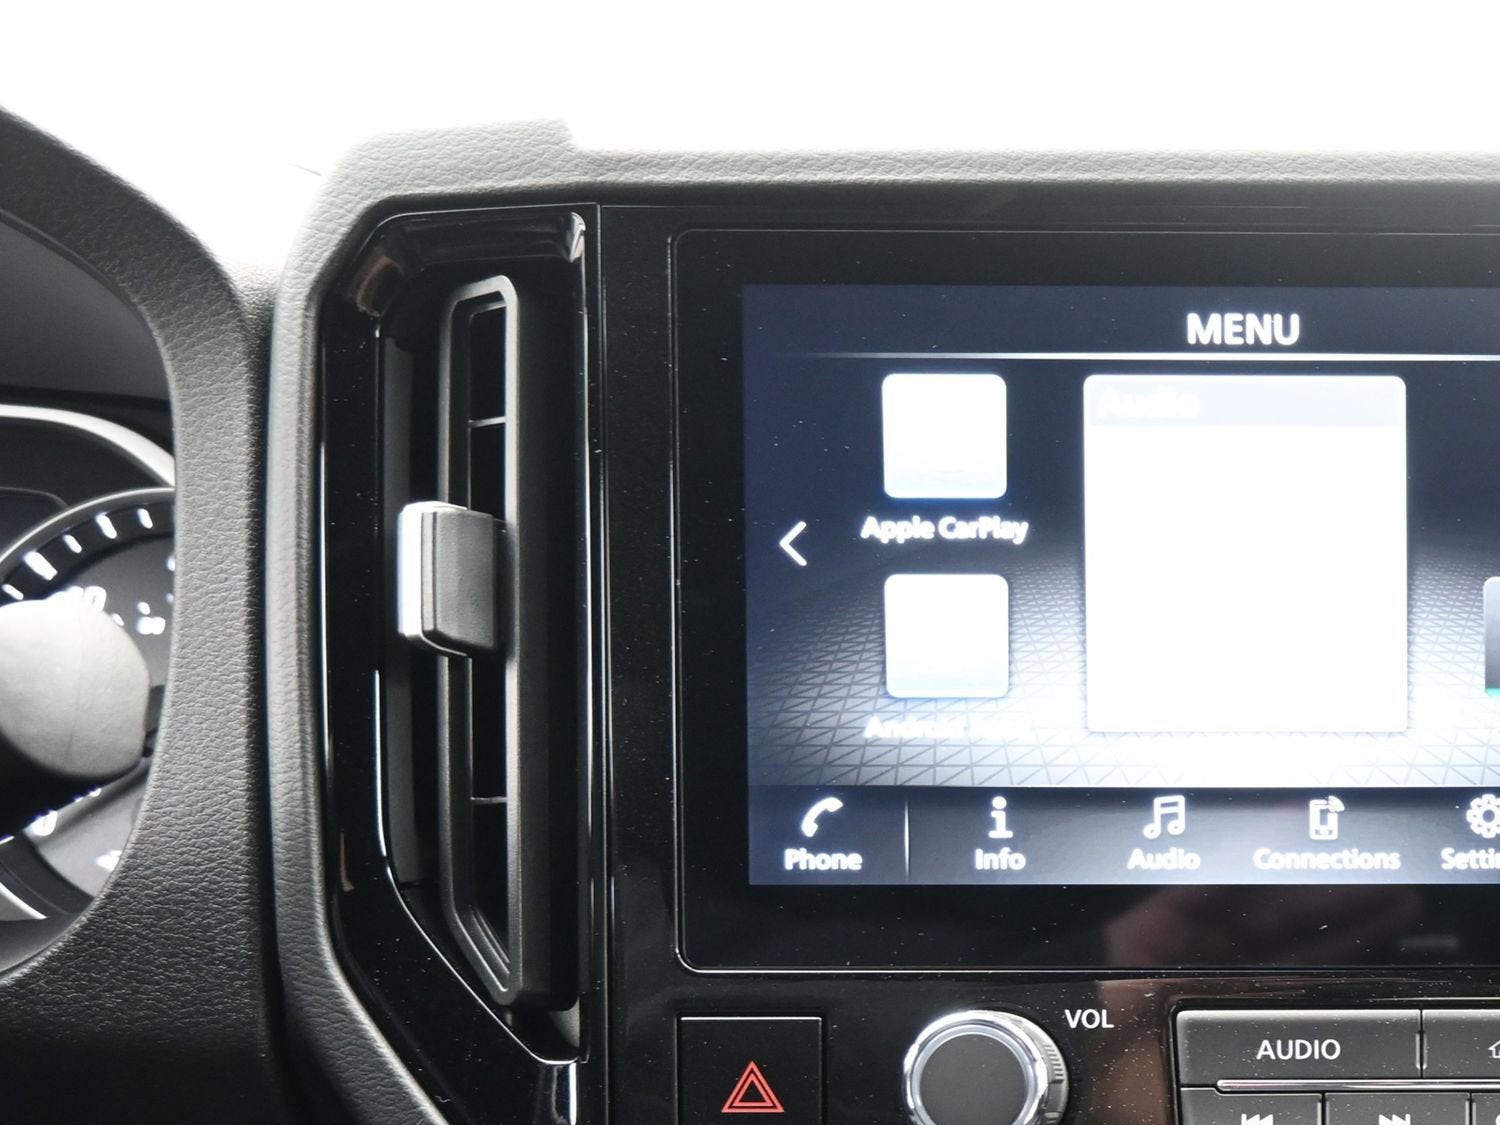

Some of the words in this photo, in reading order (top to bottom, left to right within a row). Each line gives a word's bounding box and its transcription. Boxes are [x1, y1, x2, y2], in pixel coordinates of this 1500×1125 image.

[1186, 312, 1301, 347] MENU
[860, 514, 935, 545] Apple
[937, 515, 1029, 546] CarPlay
[784, 848, 863, 871] Phone
[974, 847, 1026, 871] Info
[1128, 847, 1202, 871] Audio
[1253, 847, 1402, 871] Connections
[1064, 1008, 1115, 1029] VOL
[1256, 1038, 1341, 1060] AUDIO
